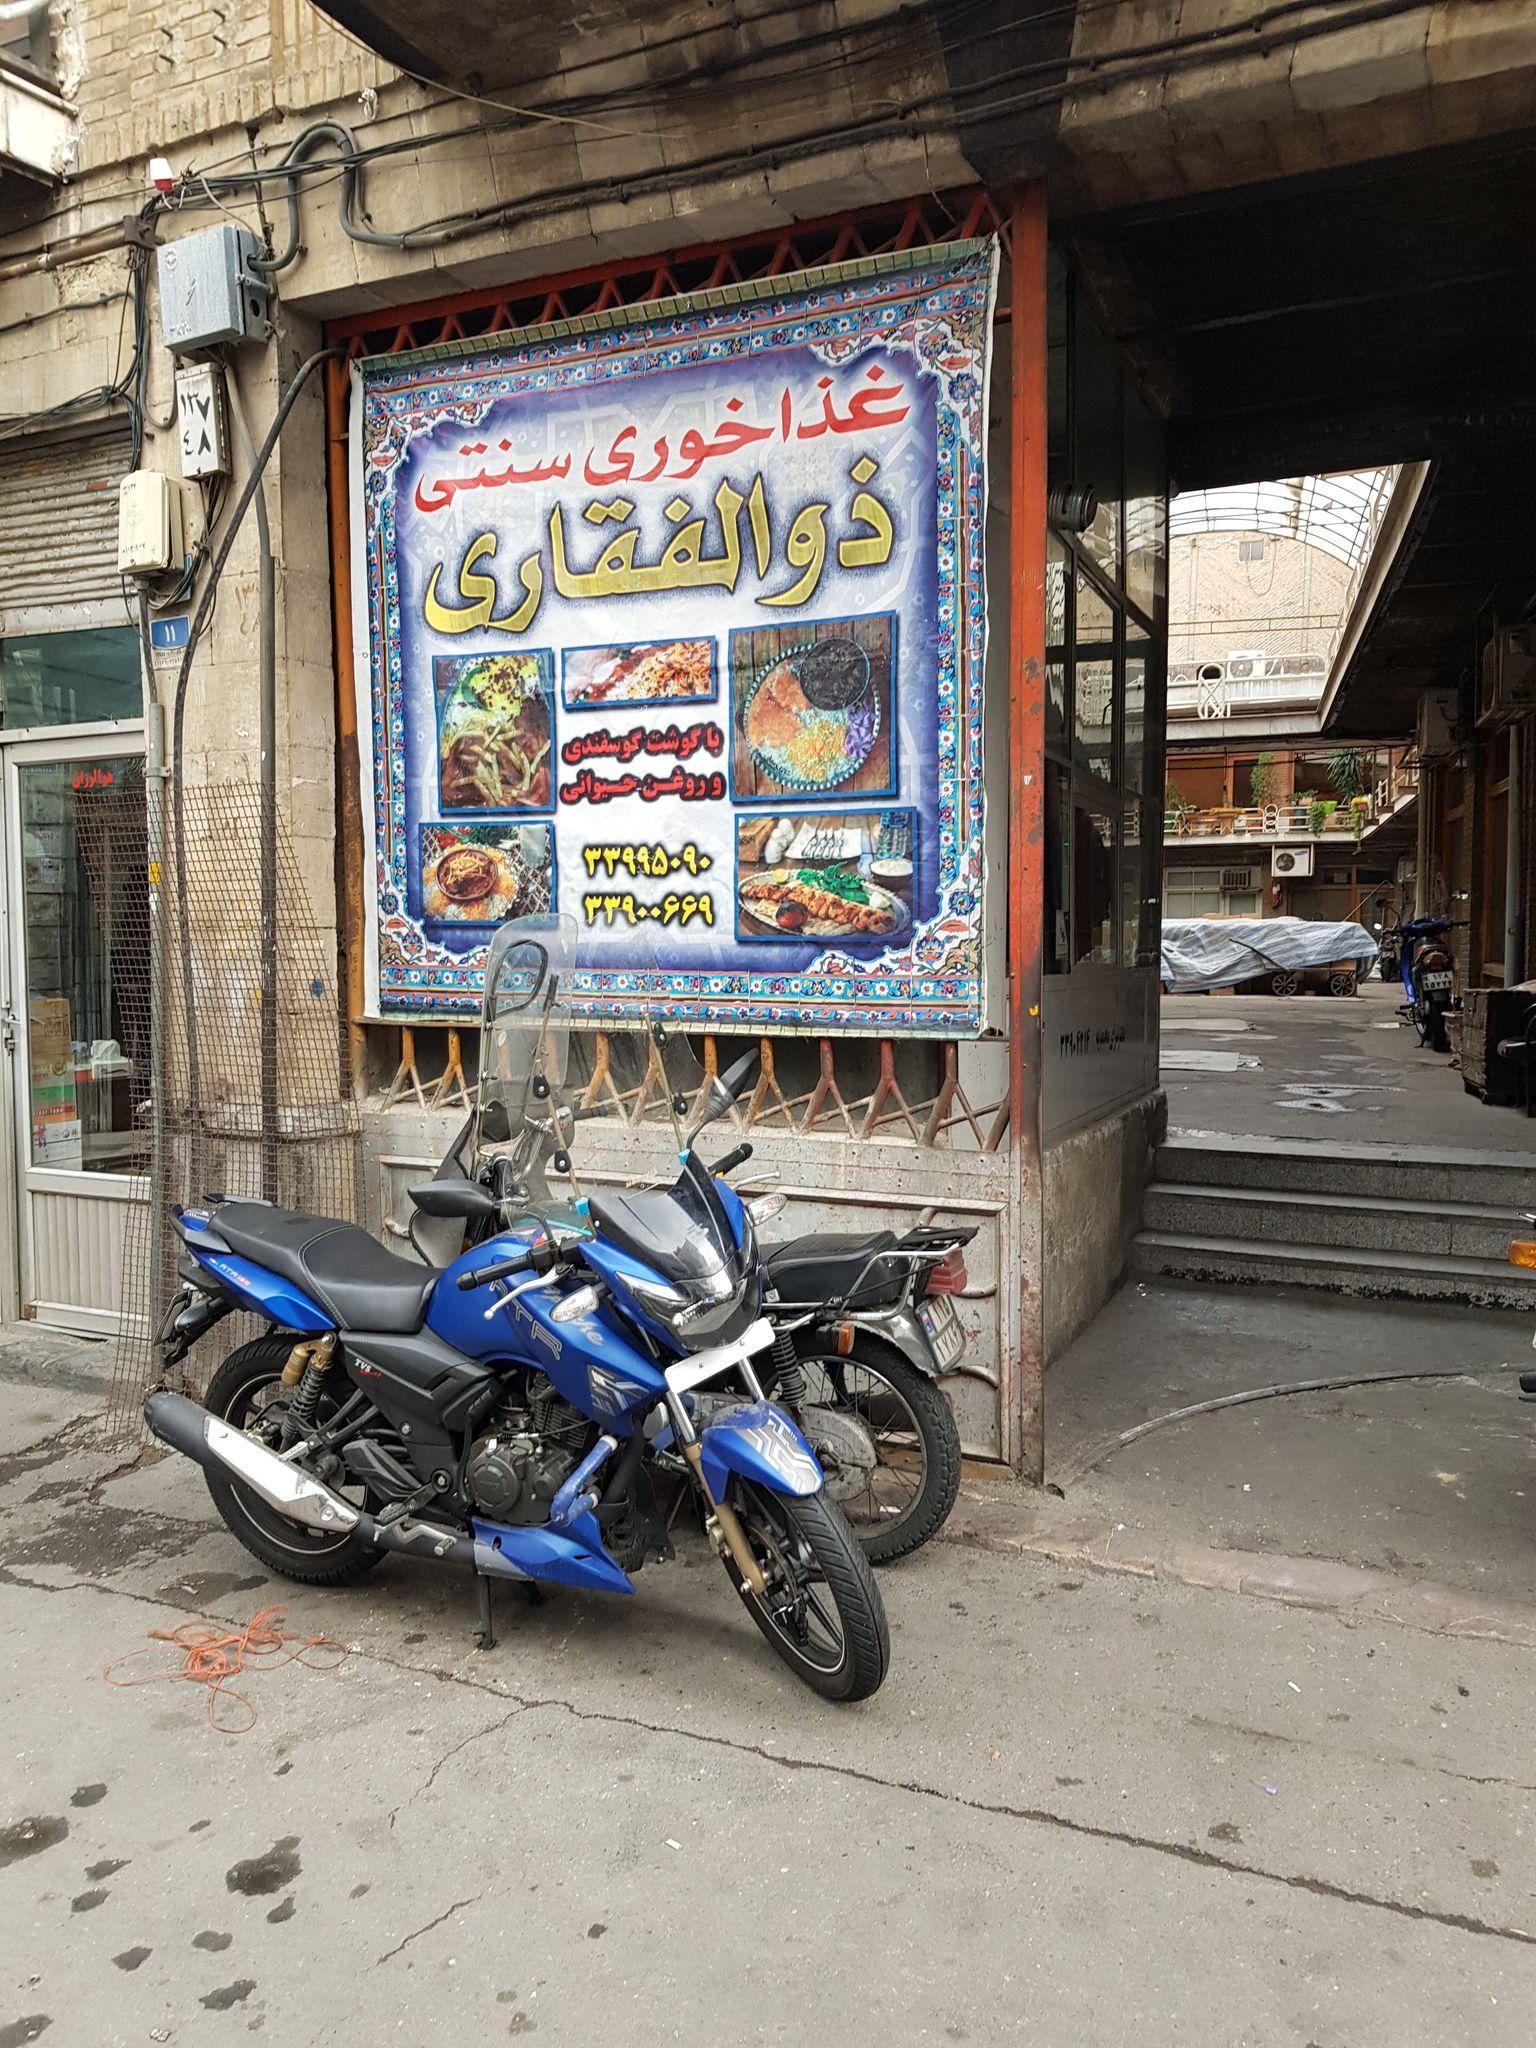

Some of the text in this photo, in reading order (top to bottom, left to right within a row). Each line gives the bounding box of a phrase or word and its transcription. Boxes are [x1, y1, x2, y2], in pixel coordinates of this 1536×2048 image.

[180, 391, 210, 423] ۱۳۷
[414, 437, 571, 512] سنتی
[424, 456, 894, 634] ذوالفقاری
[164, 624, 176, 642] ۱۱
[563, 720, 724, 762] با گوشت گوسفندی
[562, 768, 726, 802] و روغن حیوانی
[584, 845, 712, 877] ۳۳۹۹۵۰۹۰
[584, 895, 713, 926] ۳۳۹۰۰۶۶۹
